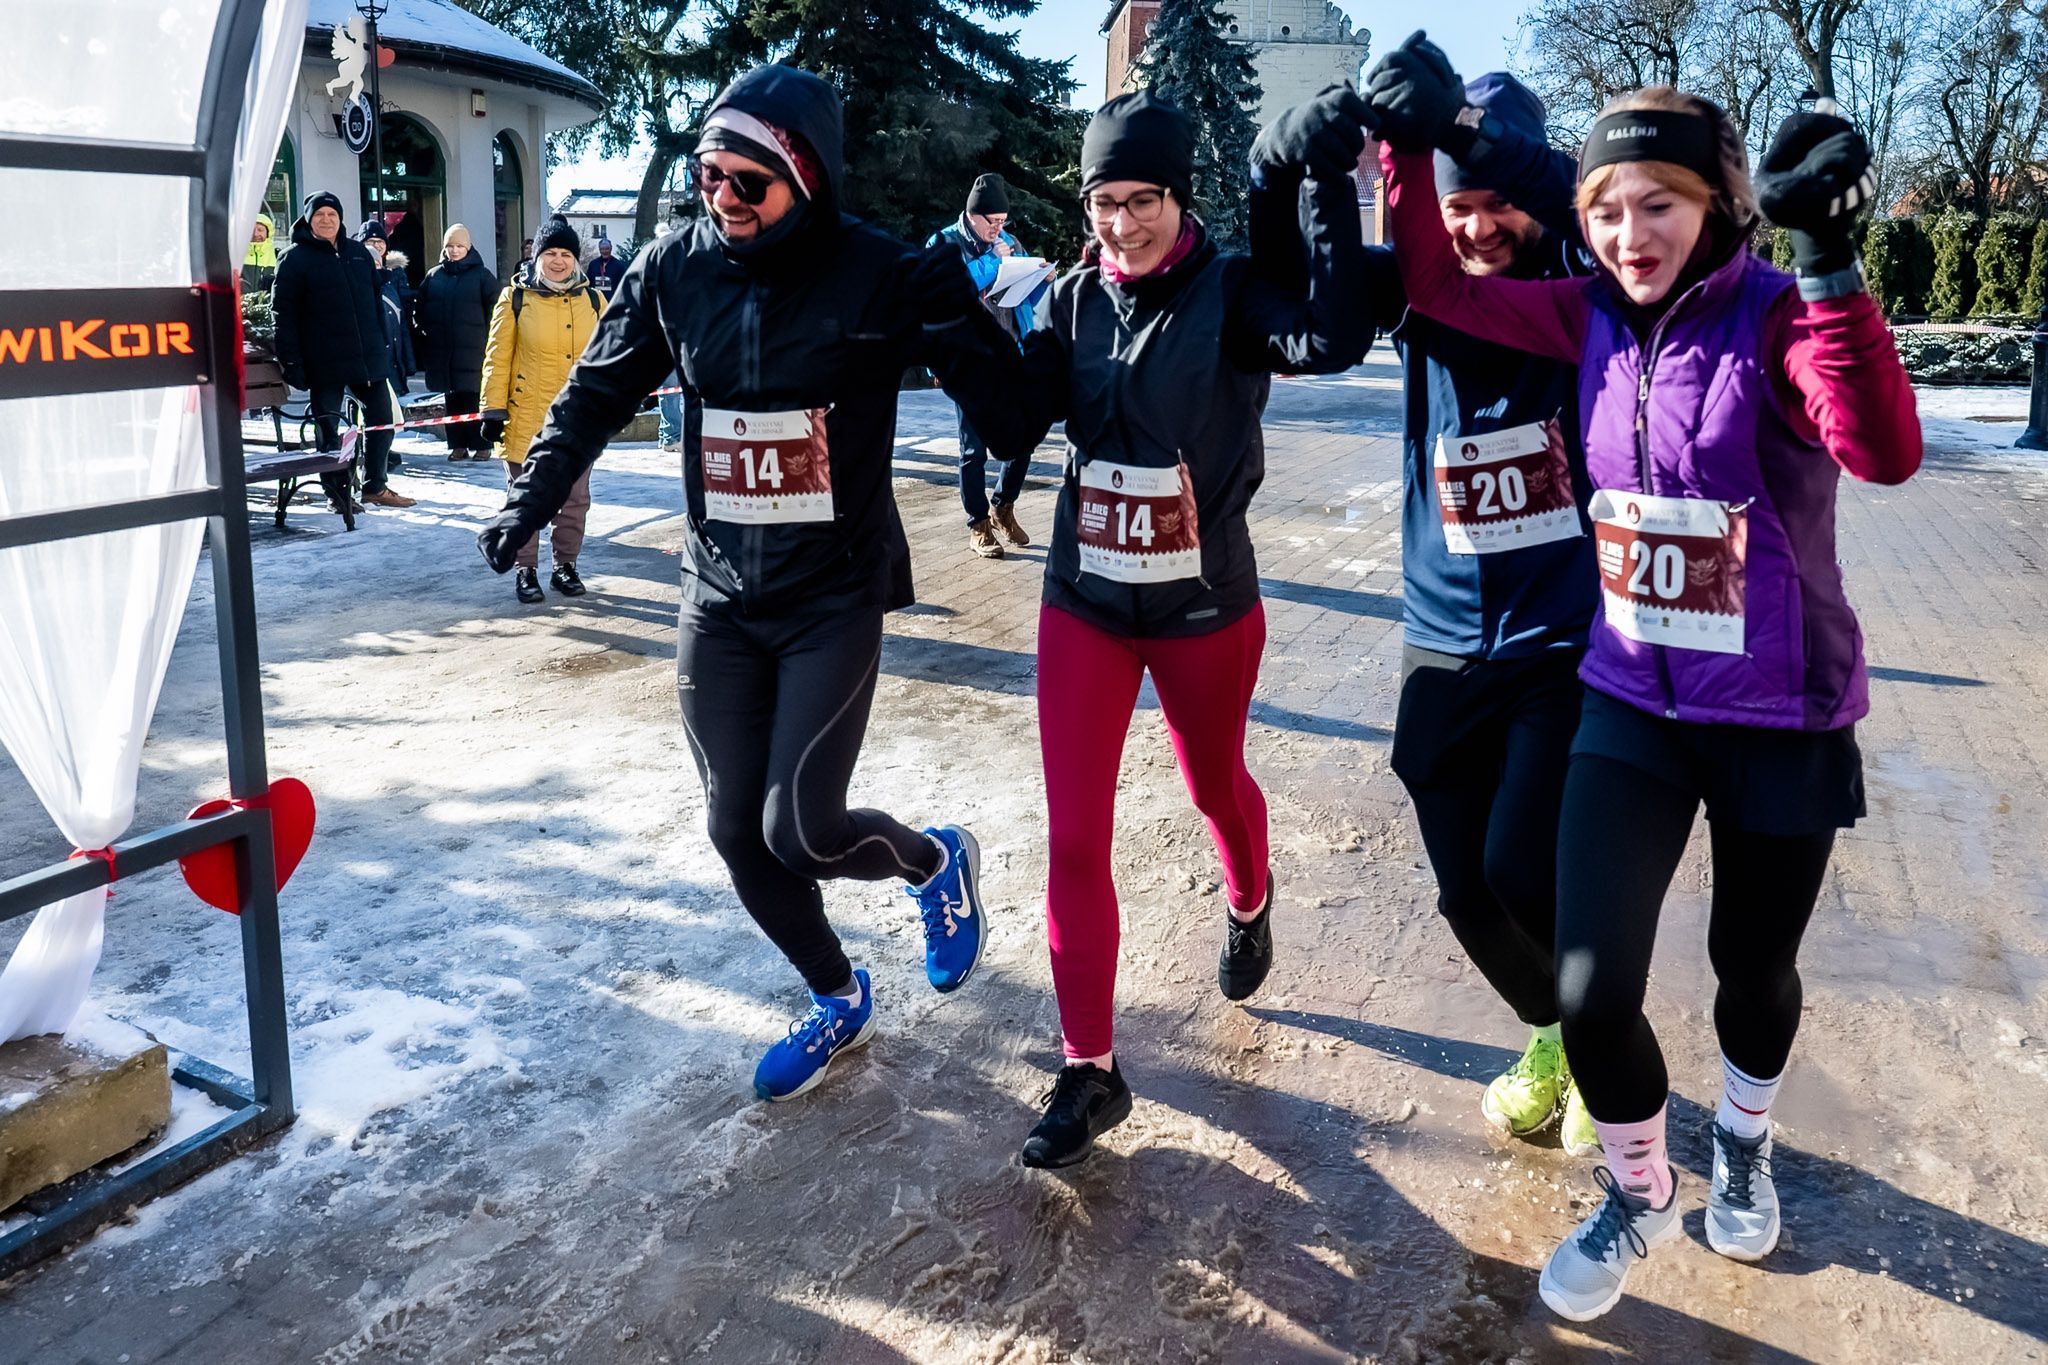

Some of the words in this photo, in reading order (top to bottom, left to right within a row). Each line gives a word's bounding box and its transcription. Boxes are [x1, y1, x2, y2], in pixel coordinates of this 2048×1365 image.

[739, 448, 784, 489] 14
[1471, 466, 1528, 516] 20
[1115, 502, 1155, 547] 14
[1627, 539, 1686, 600] 20
